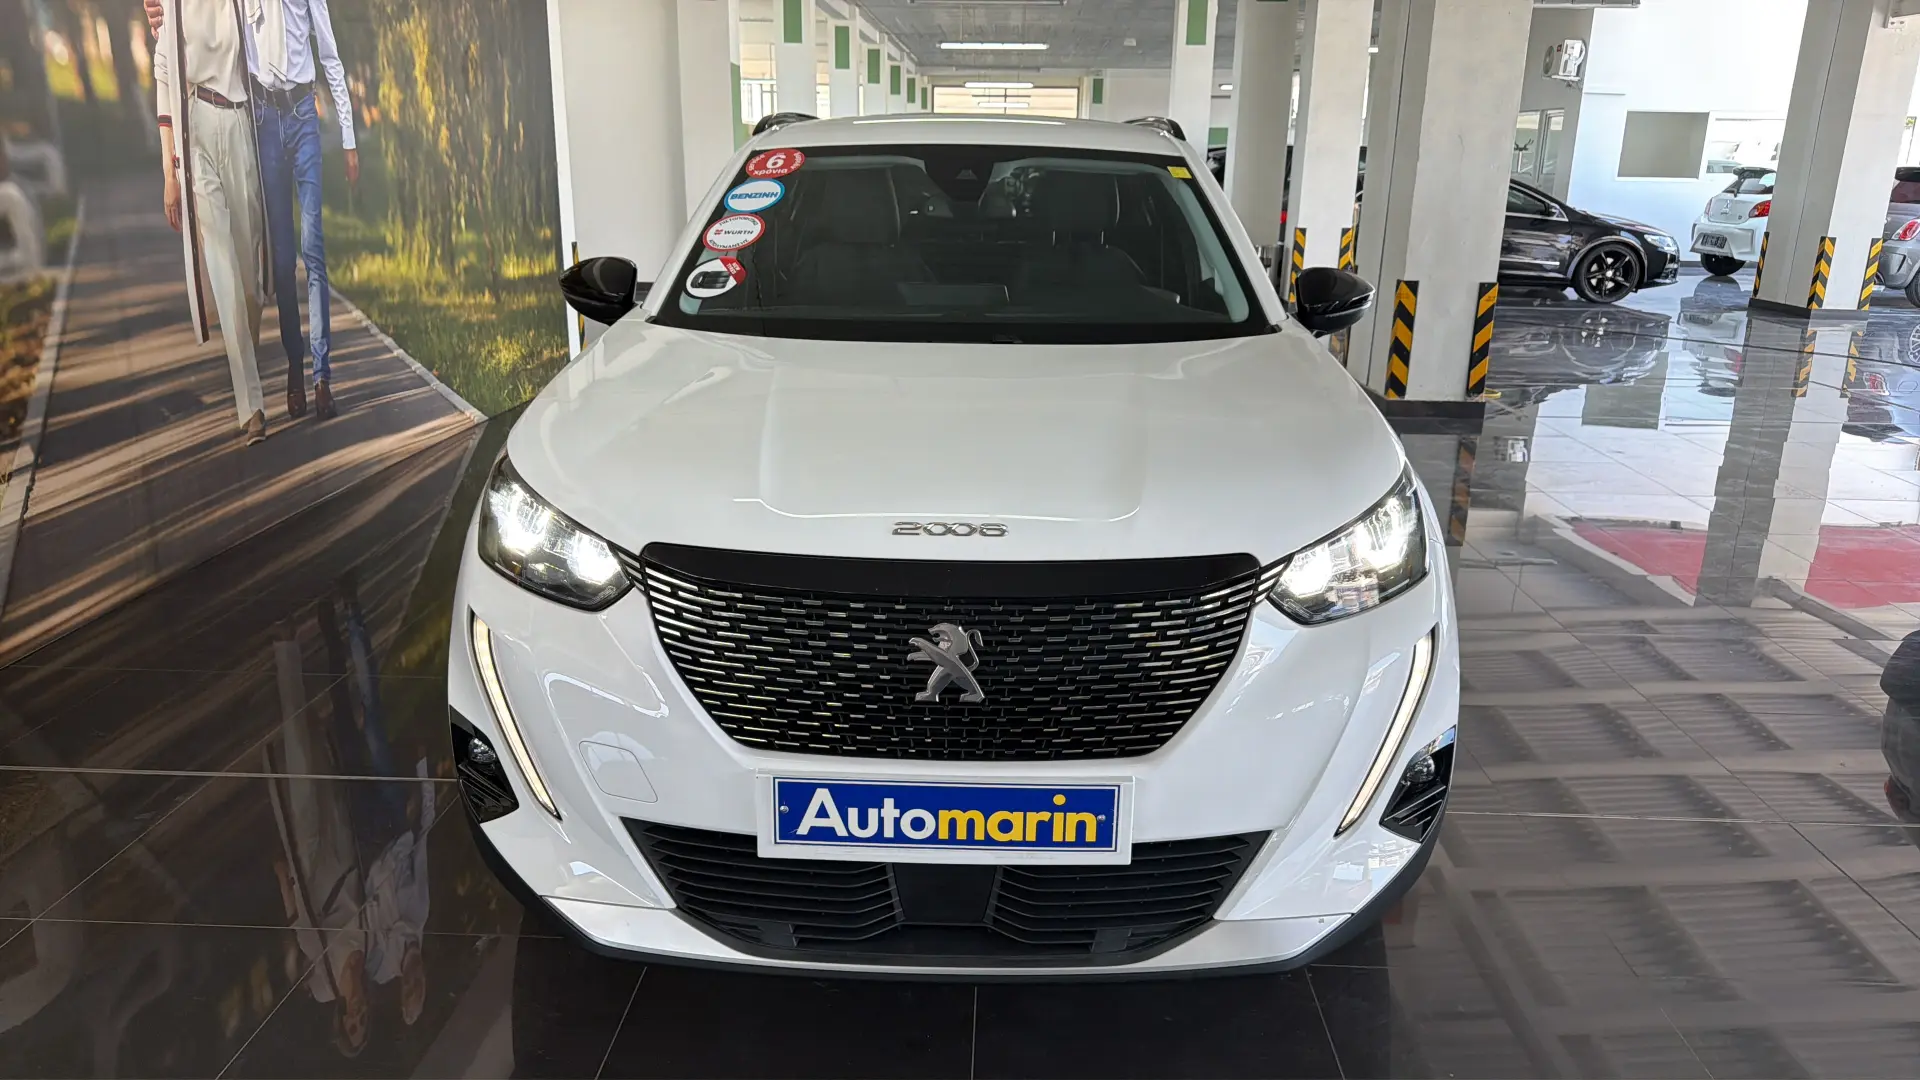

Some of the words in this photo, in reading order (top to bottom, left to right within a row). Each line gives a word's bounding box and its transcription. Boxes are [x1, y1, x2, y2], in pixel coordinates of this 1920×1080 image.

[766, 154, 786, 169] 6
[753, 168, 788, 176] χρόνια
[891, 521, 1009, 538] 2008
[796, 787, 1097, 843] Automarin
